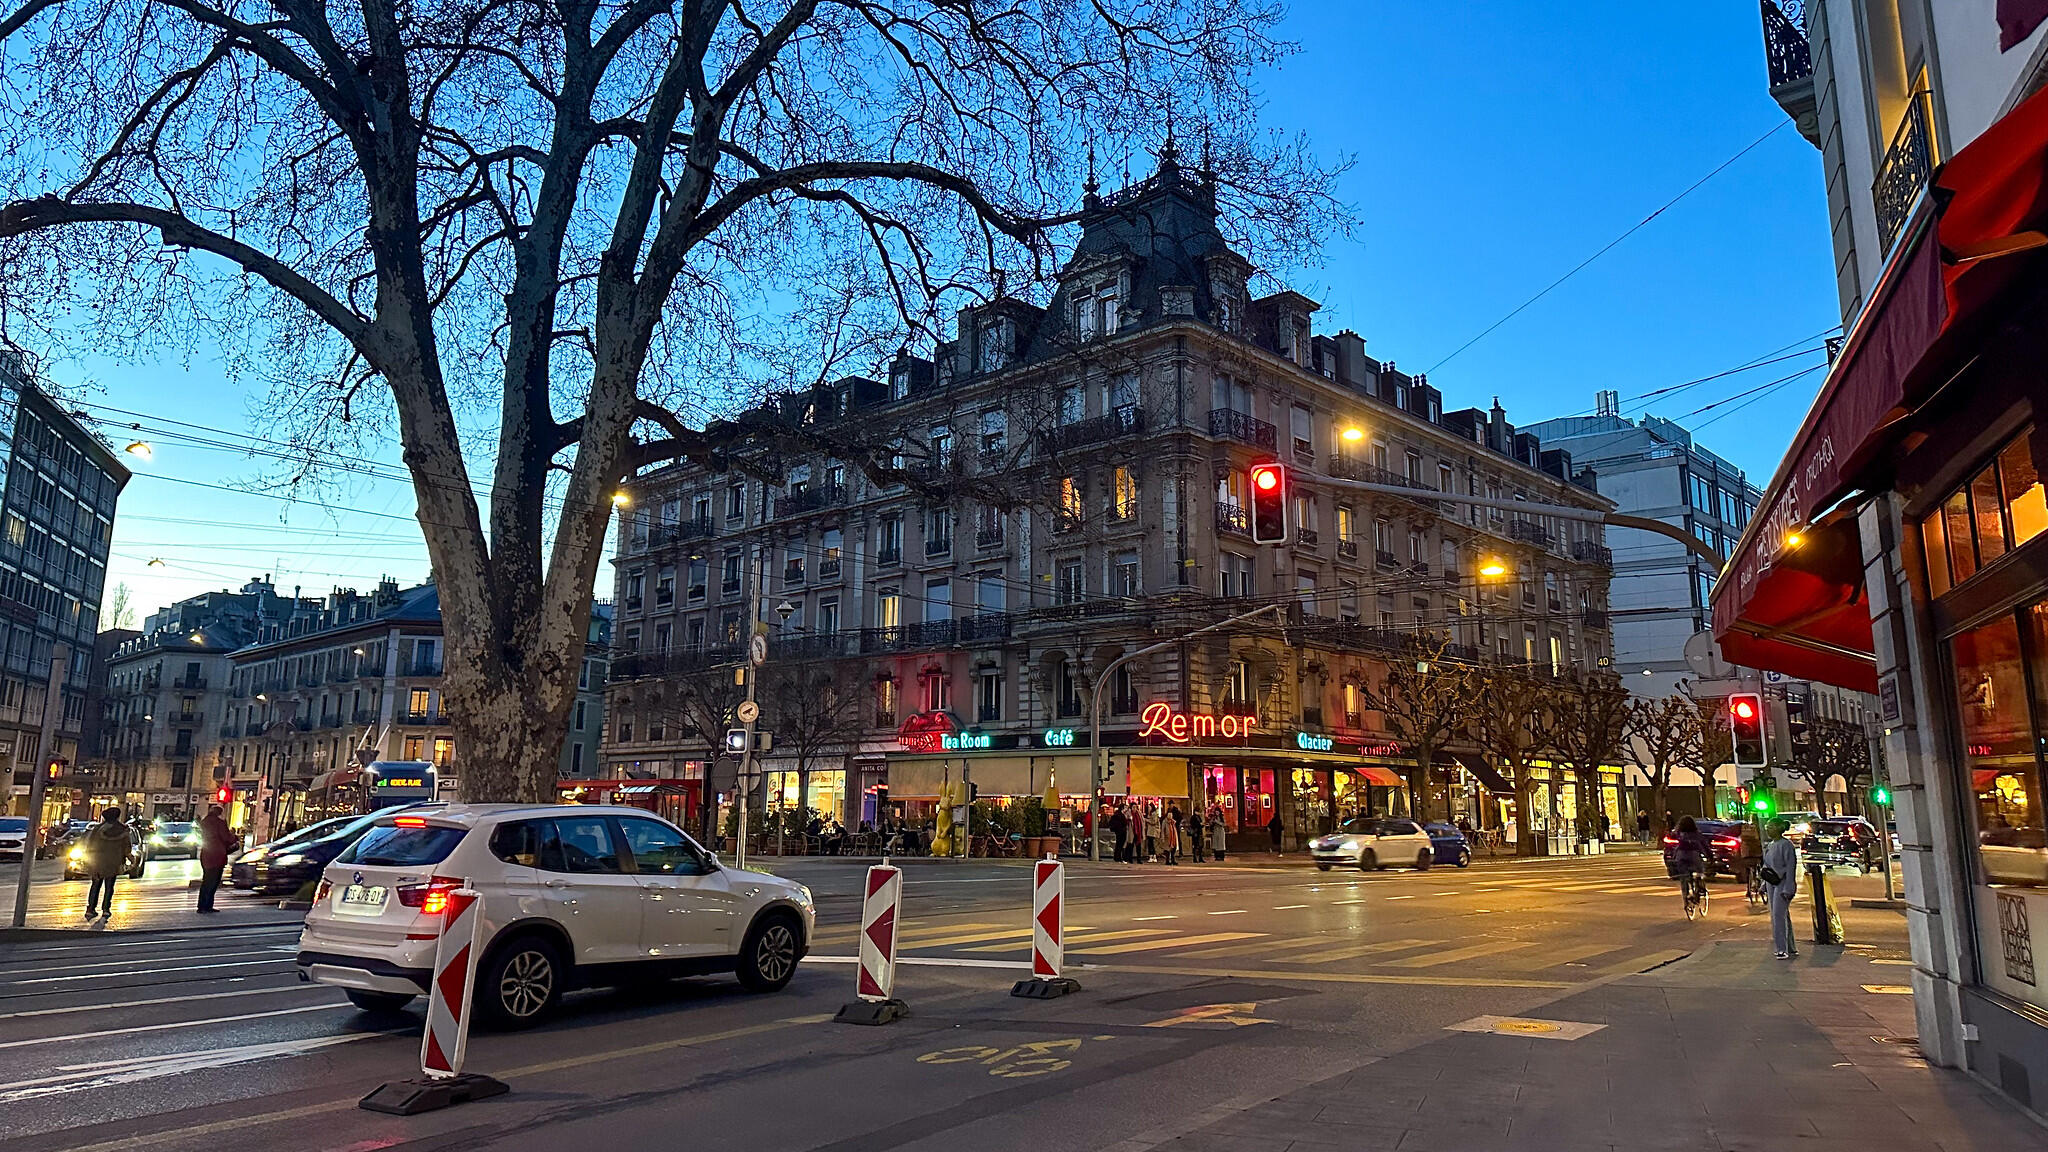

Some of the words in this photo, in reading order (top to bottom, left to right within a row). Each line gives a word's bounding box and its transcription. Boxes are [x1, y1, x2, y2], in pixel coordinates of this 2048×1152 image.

[1597, 657, 1609, 666] 40
[1138, 702, 1257, 743] Remor
[940, 733, 959, 749] Tea
[960, 732, 990, 748] Room
[1045, 729, 1074, 746] Café
[1297, 731, 1333, 751] Glacier
